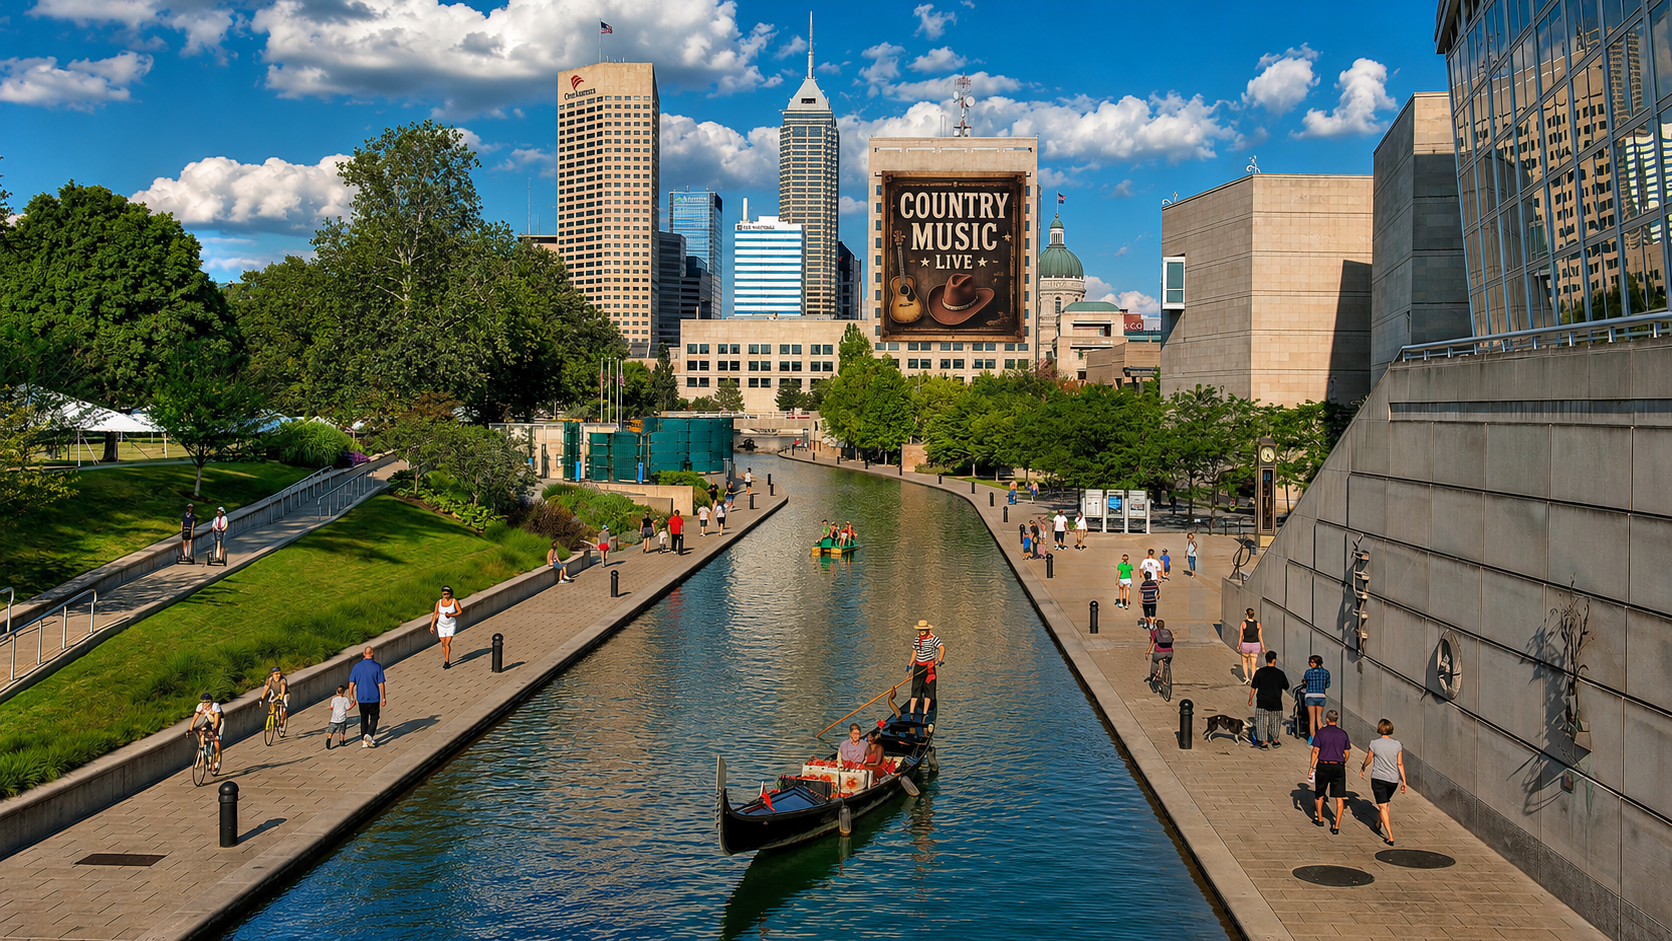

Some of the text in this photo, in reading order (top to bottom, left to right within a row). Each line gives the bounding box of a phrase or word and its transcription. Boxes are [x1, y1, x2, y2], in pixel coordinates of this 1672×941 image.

[900, 192, 1010, 219] COUNTRY
[911, 222, 998, 251] MUSIC
[935, 254, 974, 270] LIVE
